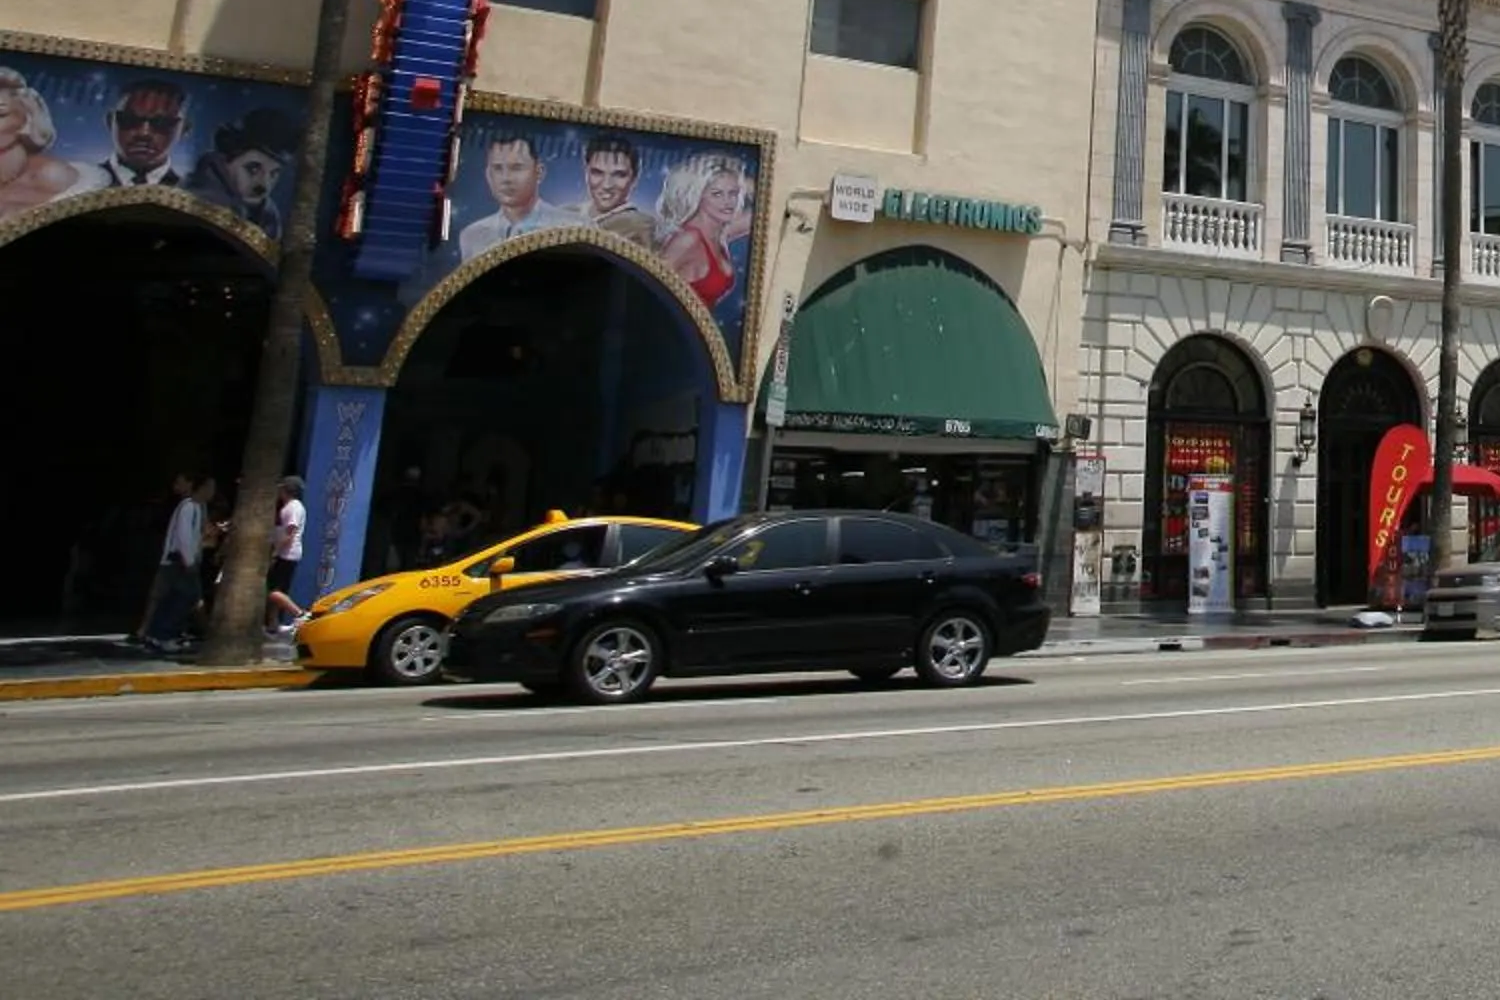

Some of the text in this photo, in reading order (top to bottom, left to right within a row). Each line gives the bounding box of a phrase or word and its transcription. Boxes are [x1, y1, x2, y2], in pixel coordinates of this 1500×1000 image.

[835, 185, 875, 198] WORLD
[838, 199, 869, 213] WIDE
[883, 188, 1043, 236] ELECTRONICS
[1375, 443, 1415, 548] TOURS
[420, 575, 461, 589] 6355
